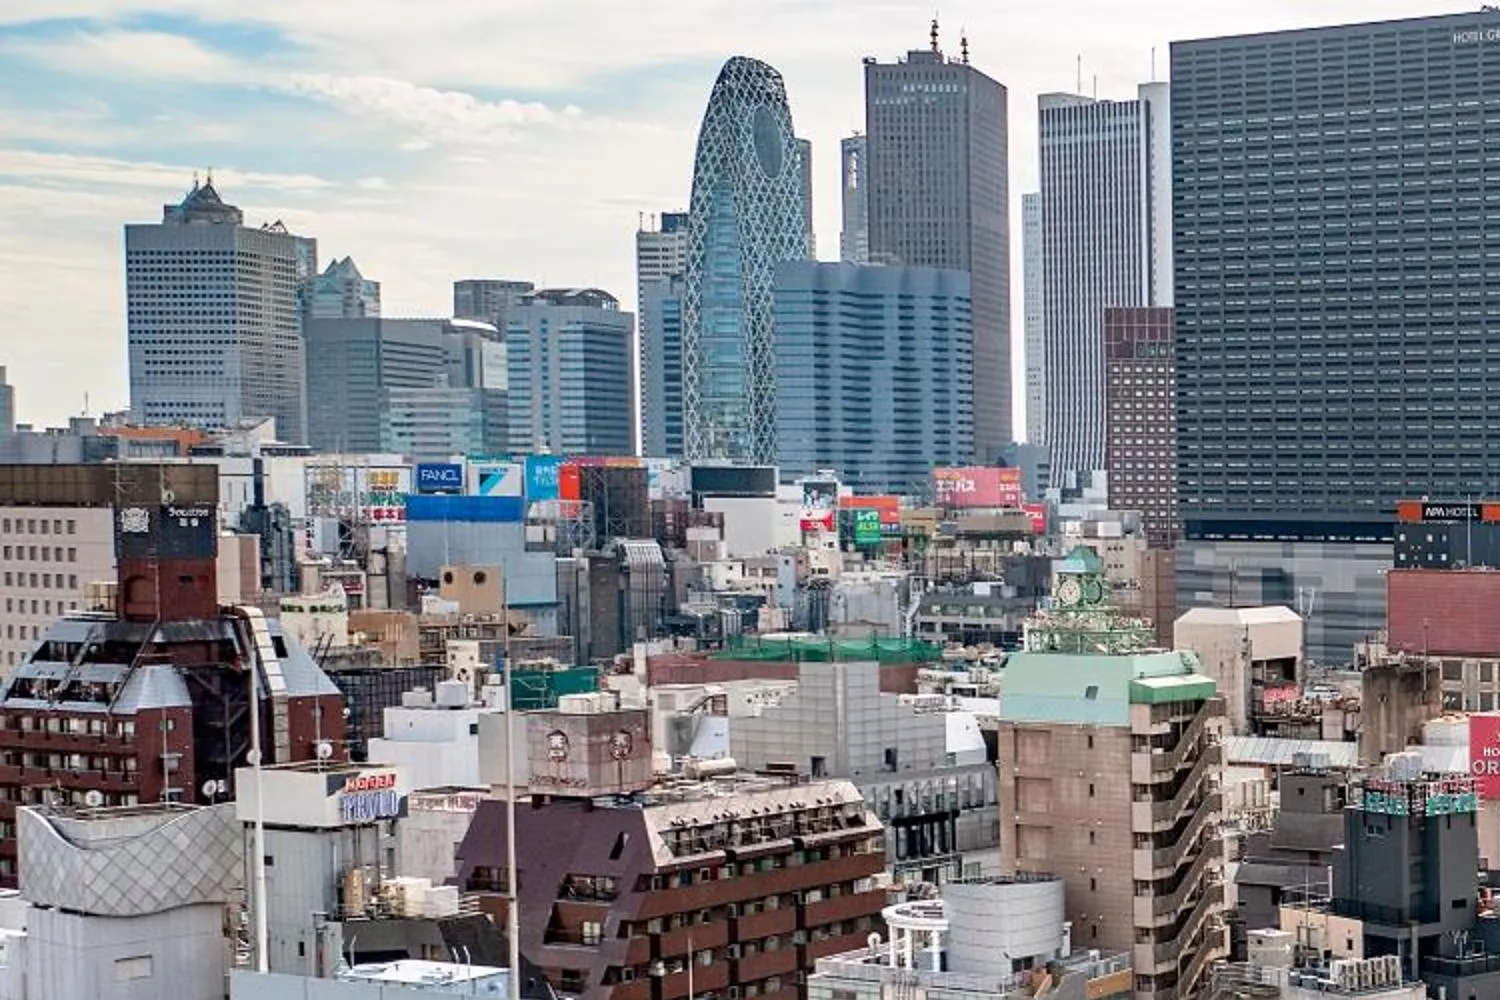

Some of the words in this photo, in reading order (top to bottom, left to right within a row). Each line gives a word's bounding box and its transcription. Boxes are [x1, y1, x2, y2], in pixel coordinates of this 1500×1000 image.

[1453, 31, 1484, 43] HOTEL
[421, 469, 459, 481] FANCL
[1425, 506, 1444, 517] APA
[1445, 507, 1479, 517] HOTEL
